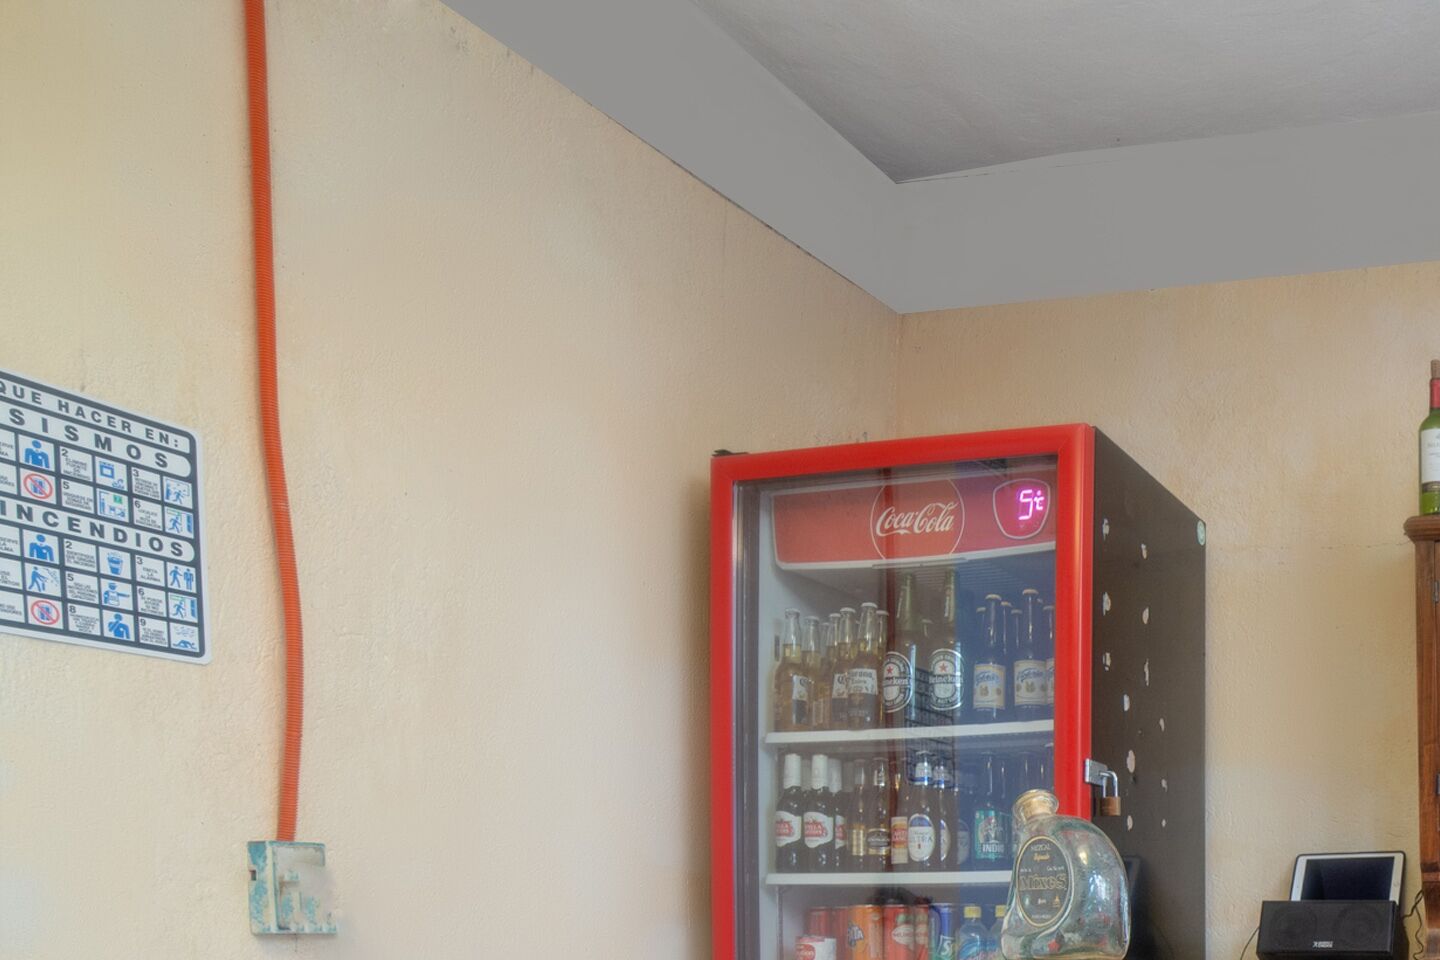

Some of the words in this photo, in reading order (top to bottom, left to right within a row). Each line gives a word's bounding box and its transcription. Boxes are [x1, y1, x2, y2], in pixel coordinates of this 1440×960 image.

[58, 400, 131, 433] HACER
[145, 428, 178, 448] EN:
[9, 408, 168, 468] SISMOS
[61, 448, 68, 457] 2
[132, 469, 139, 477] 3
[63, 481, 70, 490] 5
[876, 501, 958, 537] Coca-Cola
[0, 501, 183, 557] INCENDIOS
[65, 541, 72, 549] 2
[136, 557, 143, 565] 3
[67, 573, 74, 581] 5
[69, 605, 76, 613] 8
